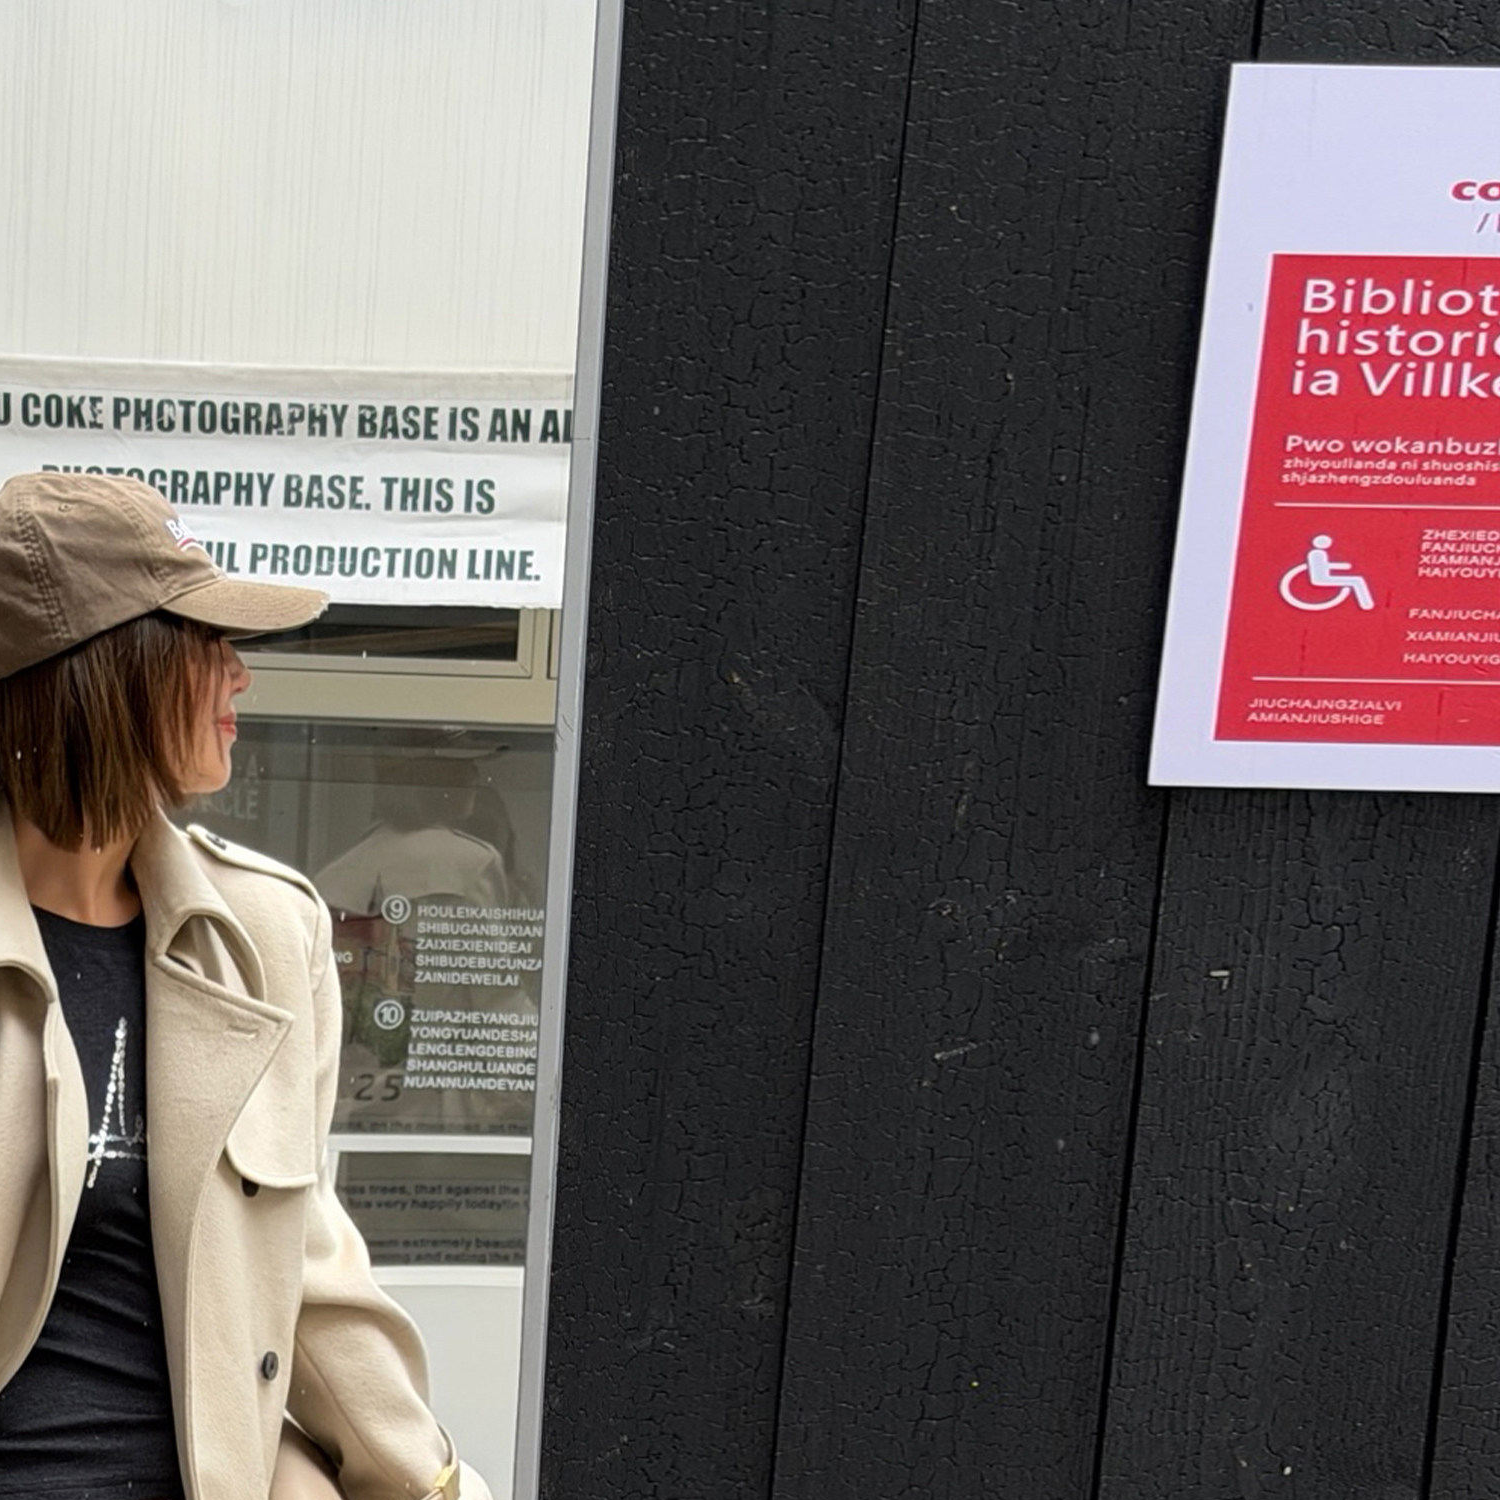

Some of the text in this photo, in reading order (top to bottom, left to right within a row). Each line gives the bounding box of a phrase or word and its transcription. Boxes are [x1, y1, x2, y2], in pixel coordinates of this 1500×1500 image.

[1303, 277, 1500, 316] Bibliot
[1297, 318, 1500, 357] histori
[1292, 359, 1339, 396] ia
[21, 393, 105, 429] COKE
[113, 397, 348, 438] PHOTOGRAPHY
[357, 404, 439, 440] BASE
[448, 407, 479, 442] IS
[488, 408, 531, 443] AN
[1285, 434, 1344, 453] Pwo
[1401, 459, 1418, 471] ni
[283, 474, 371, 511] BASE.
[381, 476, 454, 514] THIS
[463, 478, 496, 515] IS
[249, 543, 458, 580] PRODUCTION
[467, 548, 541, 582] LINE.
